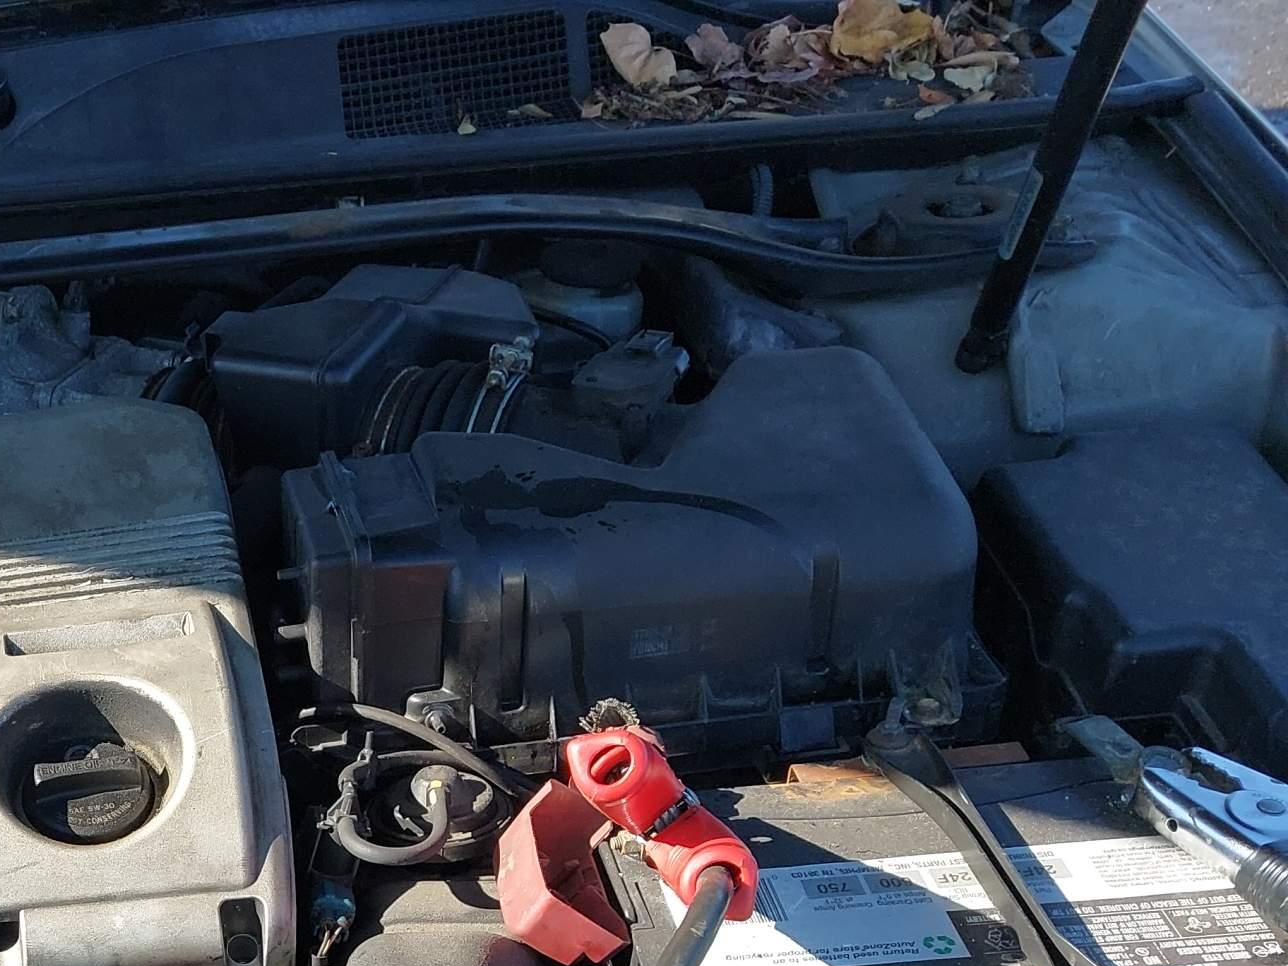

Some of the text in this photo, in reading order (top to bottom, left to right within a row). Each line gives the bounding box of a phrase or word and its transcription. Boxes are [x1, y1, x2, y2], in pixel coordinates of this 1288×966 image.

[88, 803, 115, 812] 5W-30
[87, 801, 131, 824] CONSERVING
[936, 871, 971, 883] 24F
[817, 882, 850, 894] 750
[777, 949, 812, 957] proper
[832, 945, 860, 954] store
[882, 948, 919, 956] Return
[726, 952, 773, 962] recycling
[803, 953, 850, 963] batteries
[853, 951, 879, 959] used
[1201, 953, 1224, 961] EYES
[1142, 956, 1162, 965] NO
